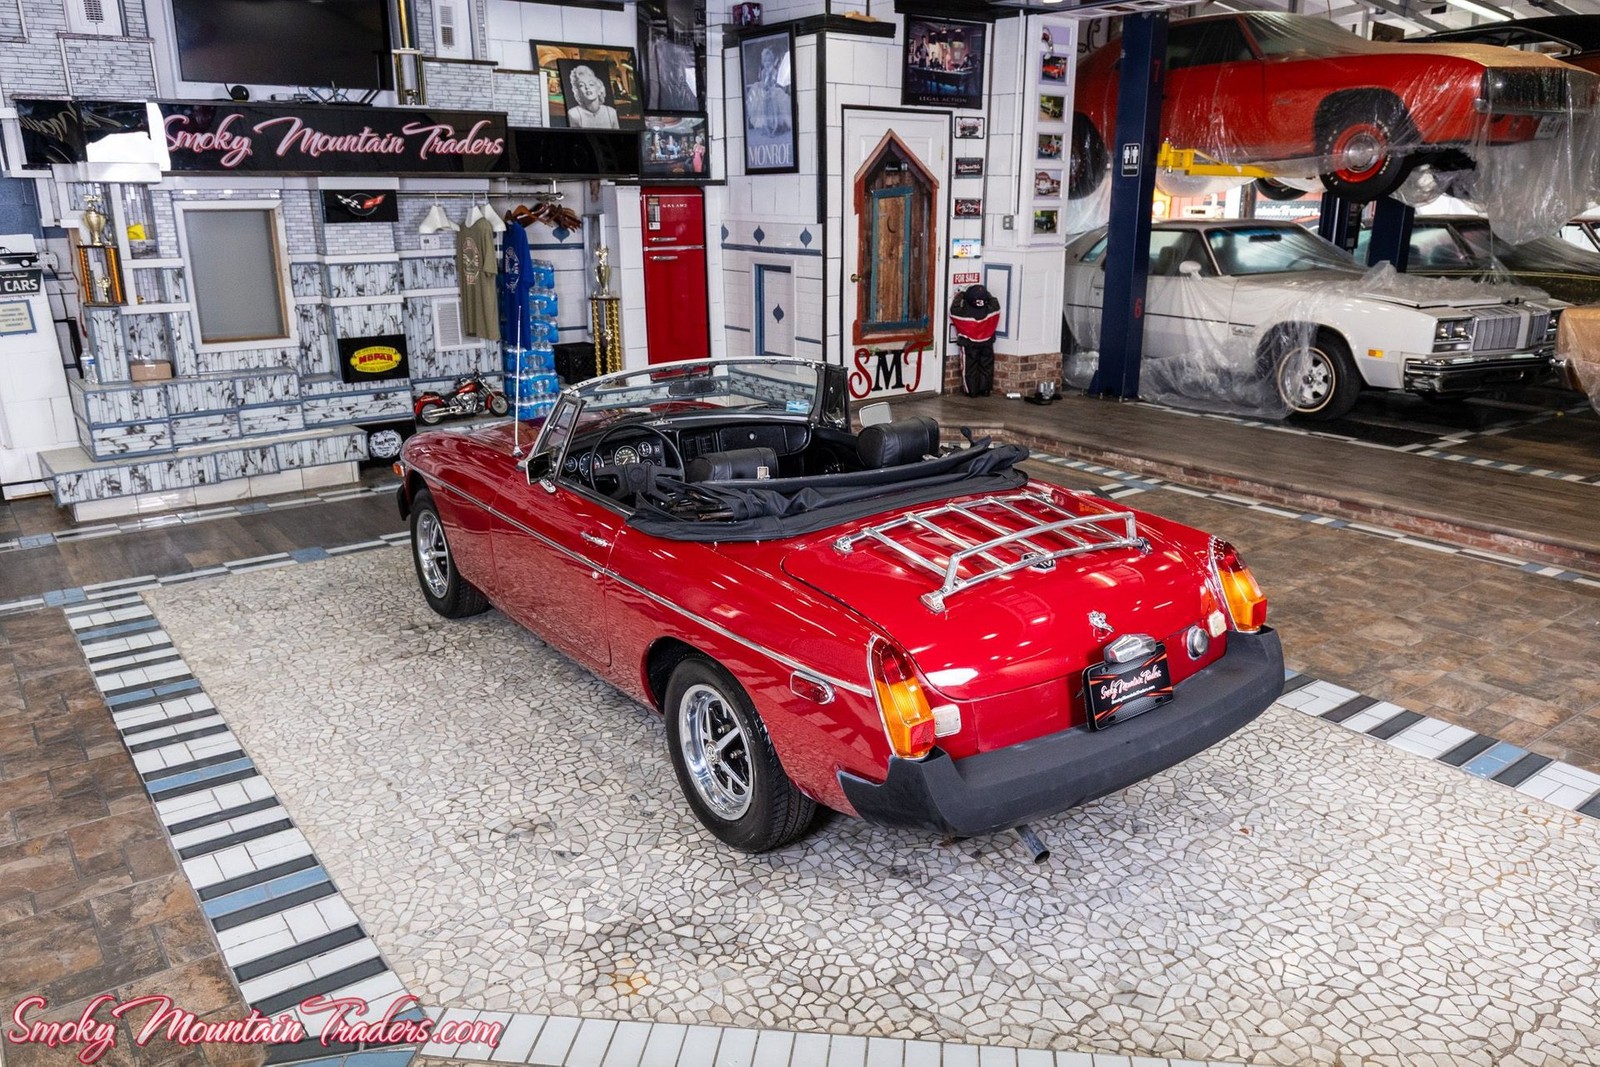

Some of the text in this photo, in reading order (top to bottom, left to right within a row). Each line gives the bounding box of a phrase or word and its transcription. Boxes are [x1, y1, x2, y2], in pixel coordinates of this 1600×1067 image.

[164, 113, 504, 168] Smoky Mountain Traders
[748, 143, 793, 166] MONROE
[955, 273, 979, 283] FOR SALE
[4, 280, 38, 292] CARS
[358, 353, 393, 364] MOPAR
